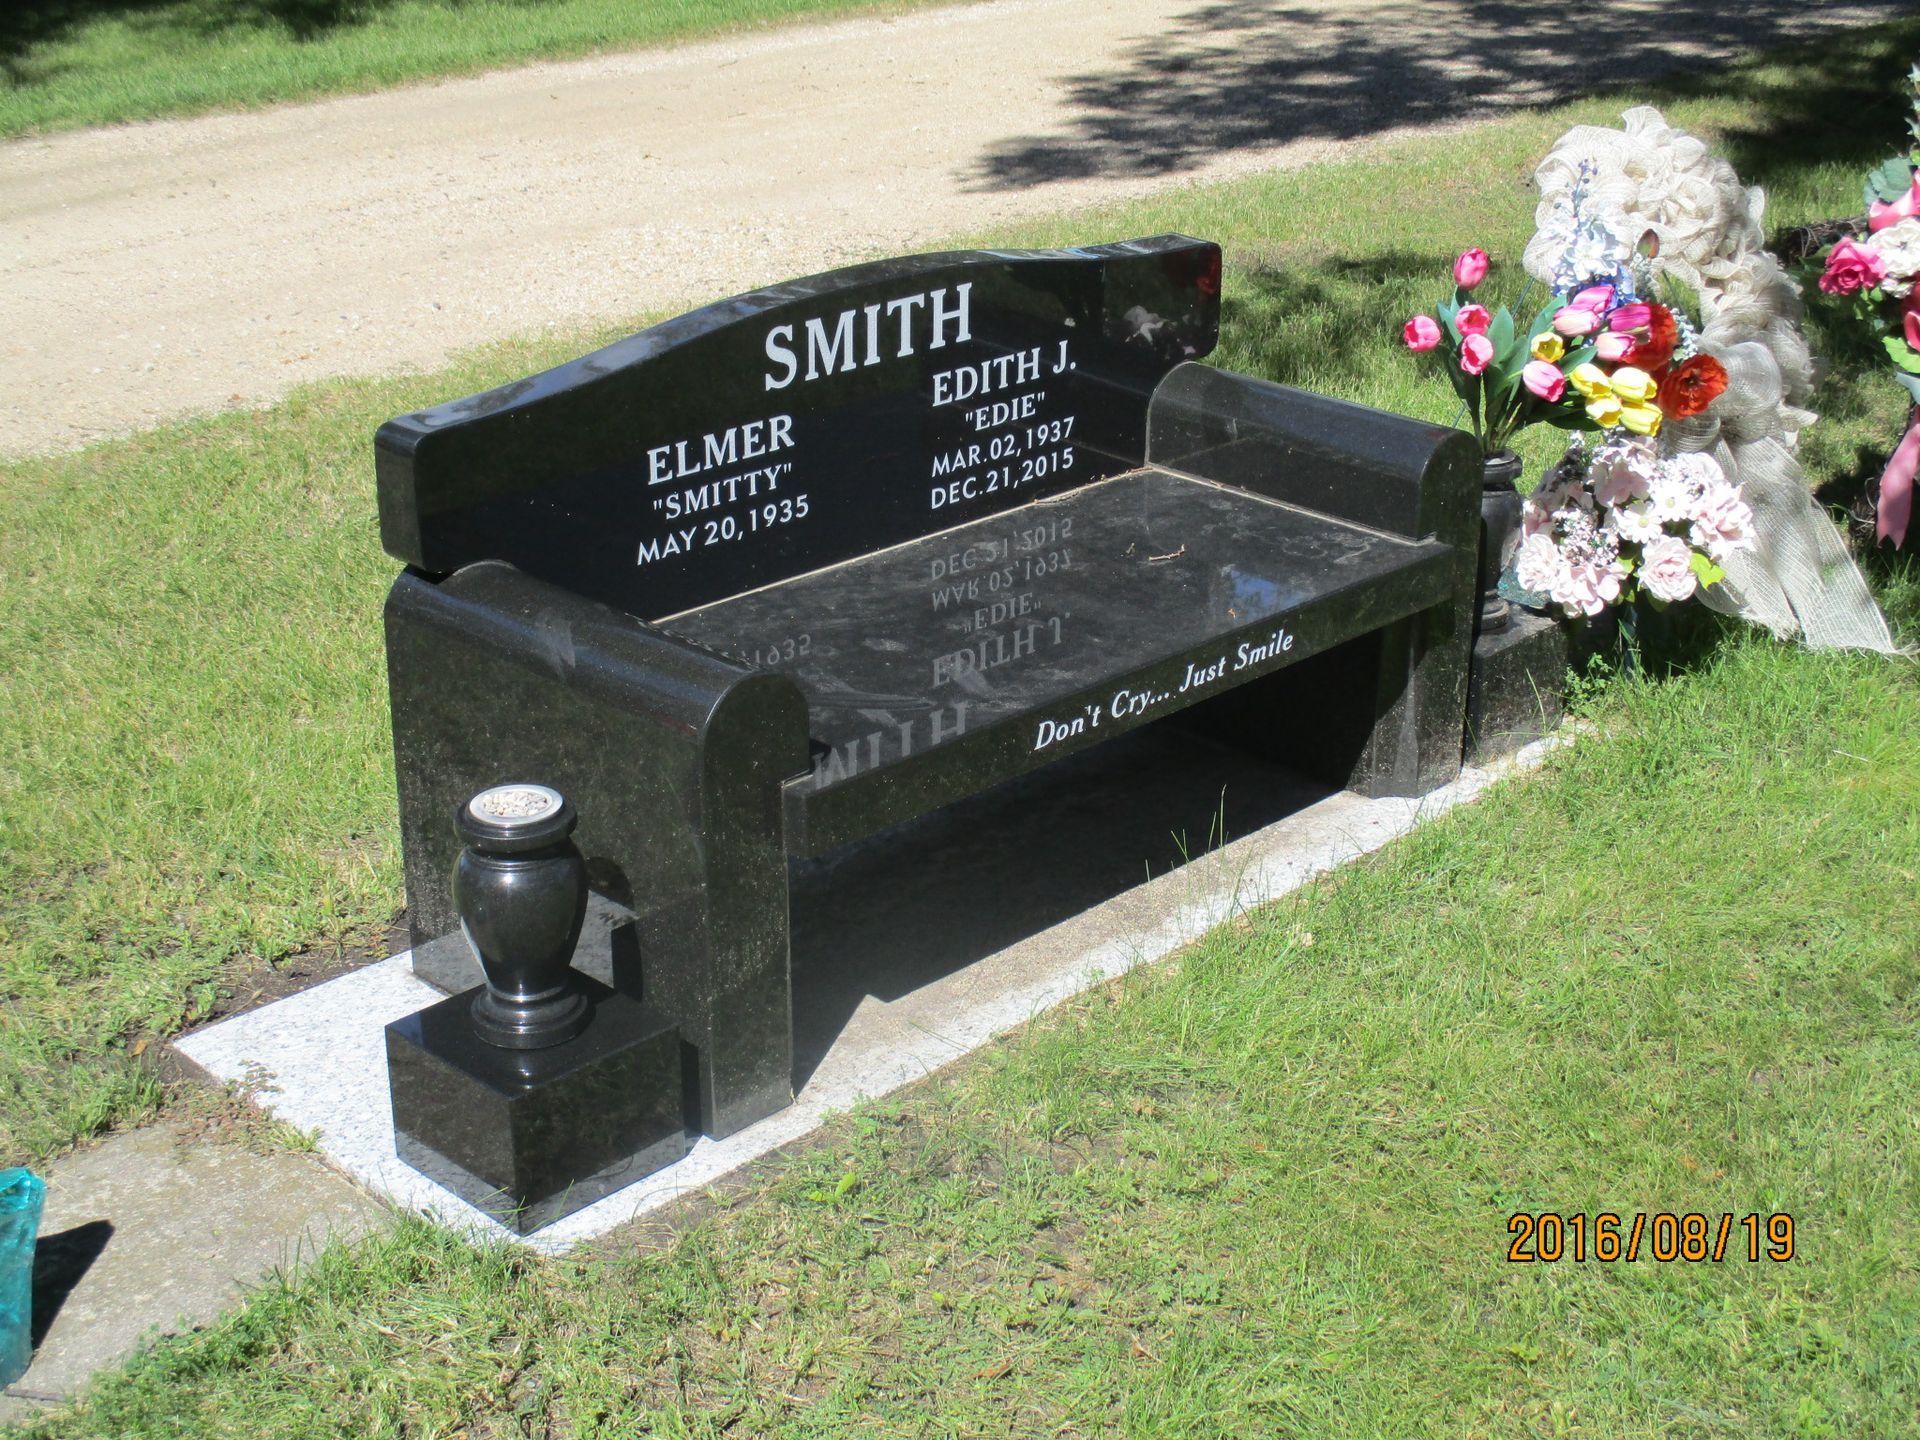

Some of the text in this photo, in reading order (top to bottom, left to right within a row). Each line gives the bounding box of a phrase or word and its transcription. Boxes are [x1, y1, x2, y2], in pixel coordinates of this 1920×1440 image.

[764, 282, 973, 392] SMITH
[931, 339, 1077, 407] EDITH J.
[964, 391, 1046, 432] "EDIE"
[646, 414, 795, 486] ELMER
[652, 462, 792, 520] "SMITTY"
[637, 526, 698, 566] MAY
[1033, 628, 1294, 751] Don't Cry... Just Smile
